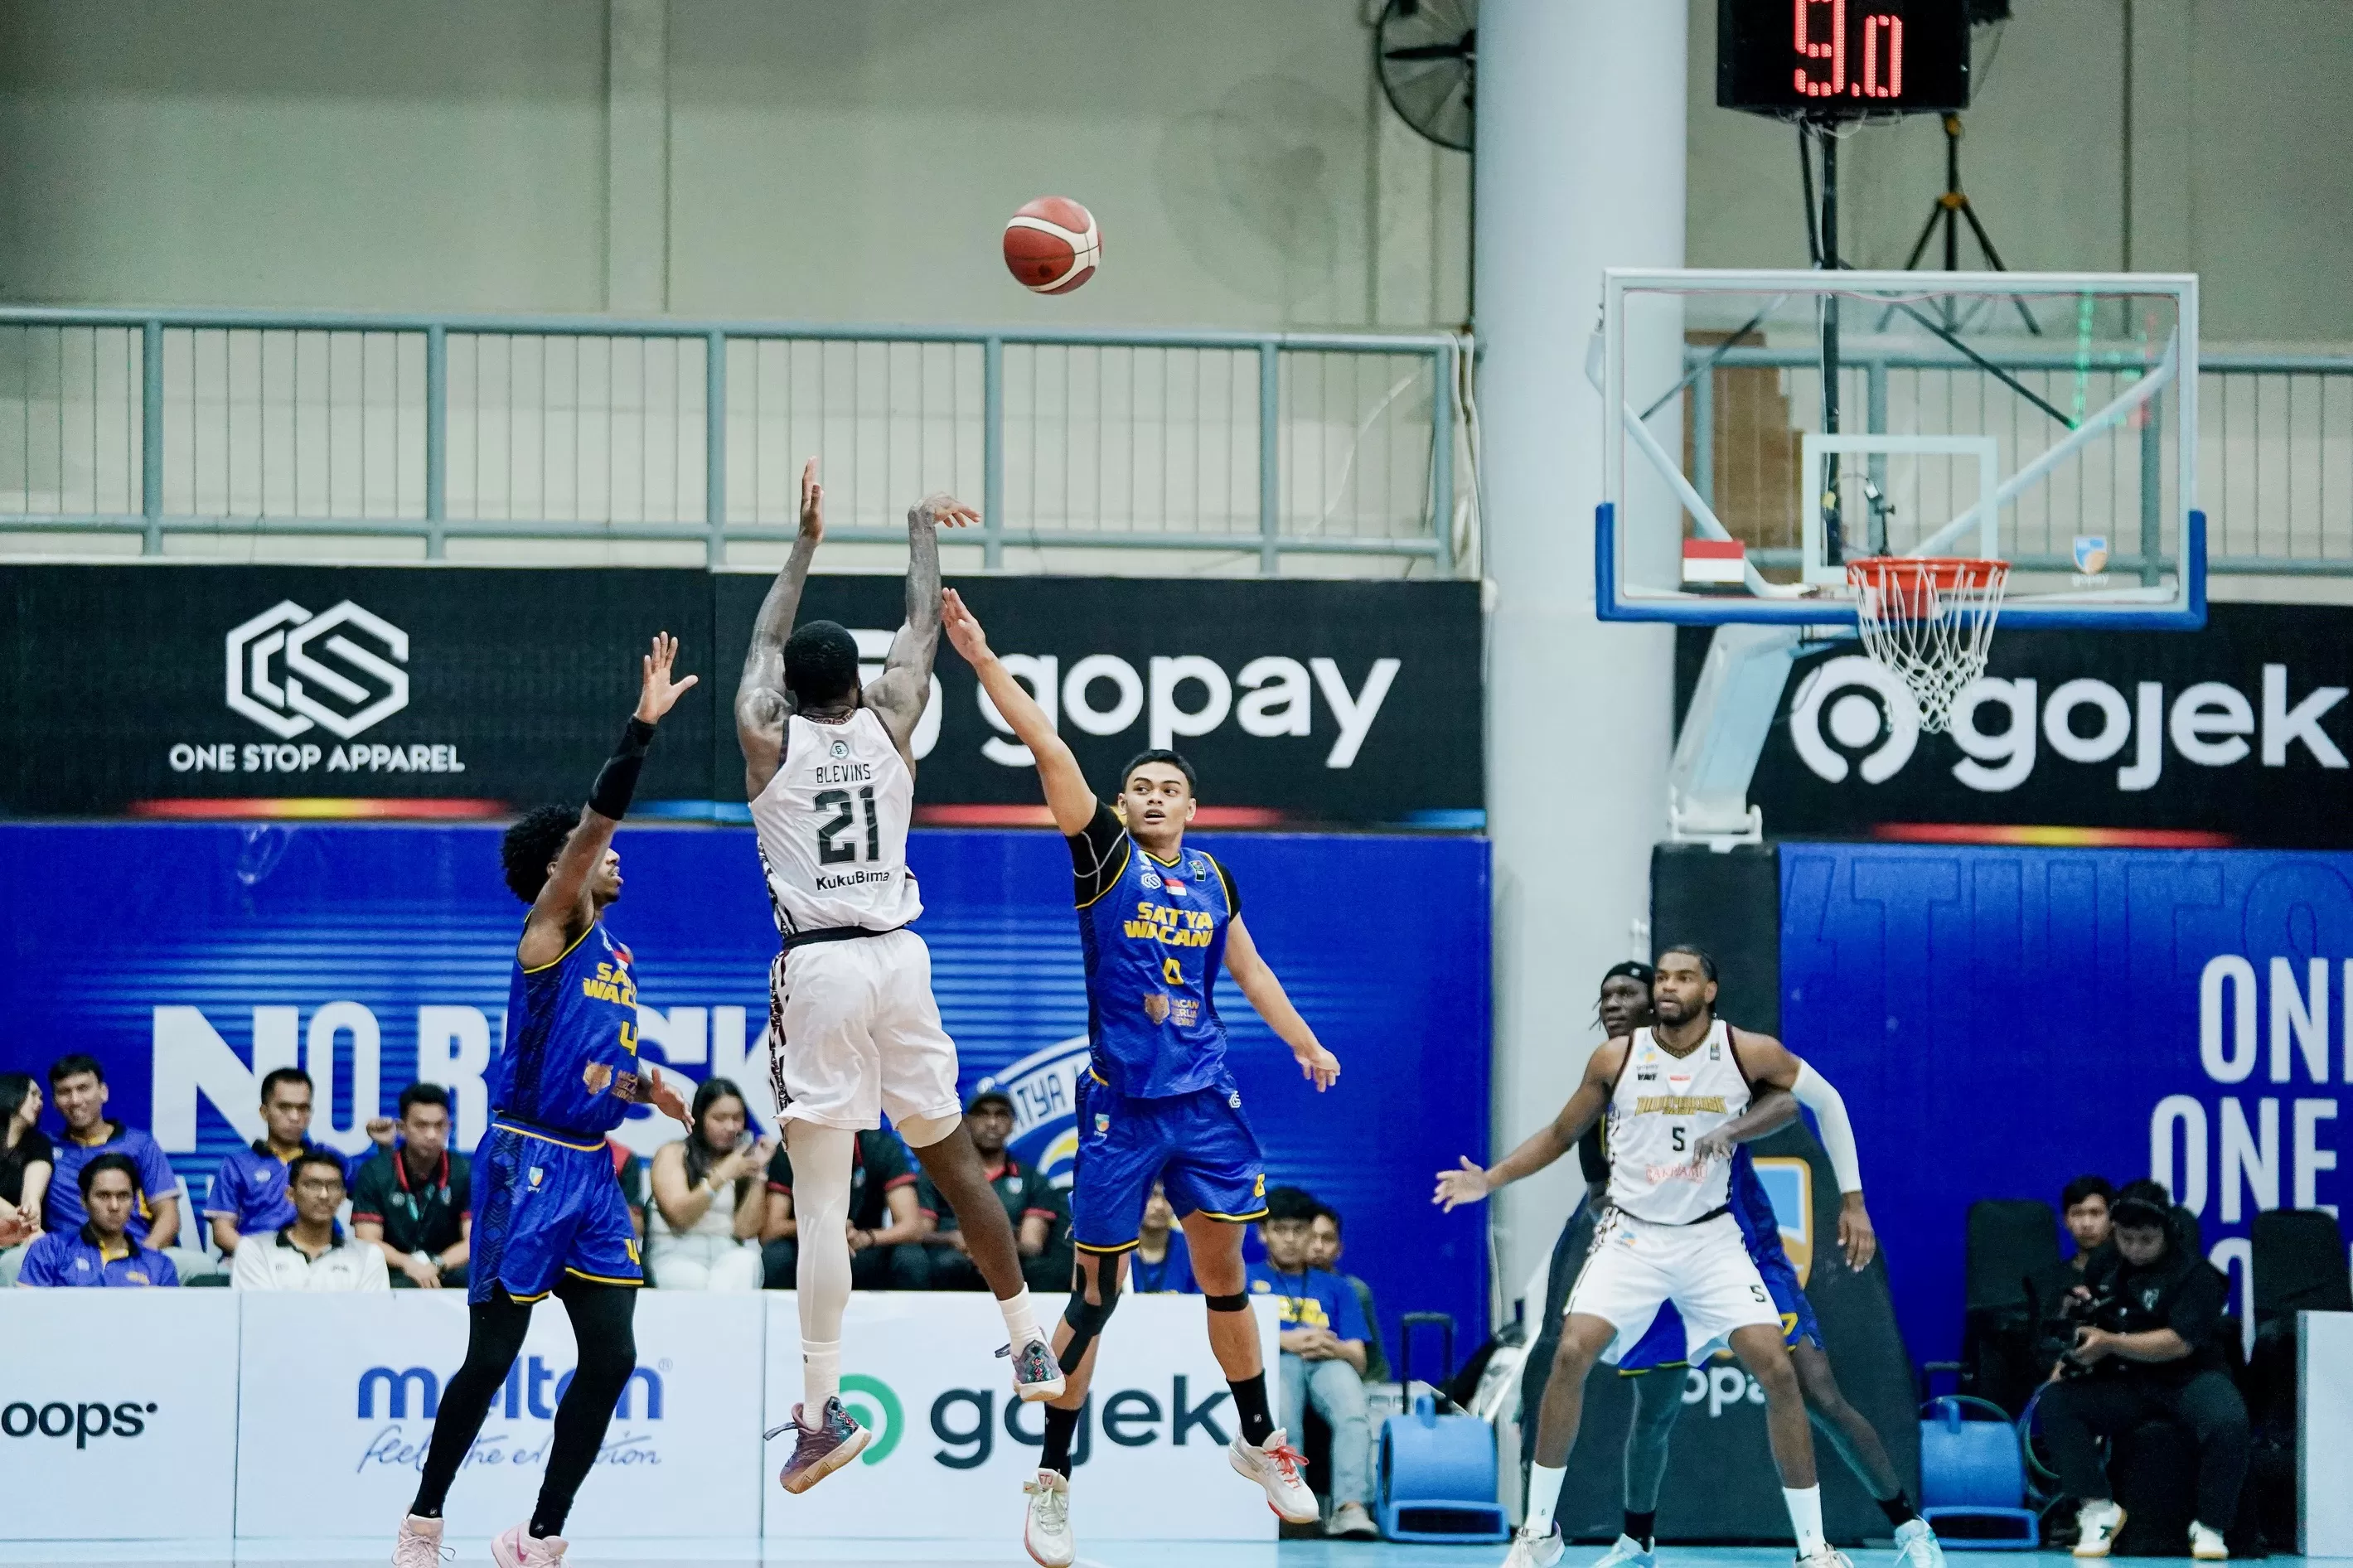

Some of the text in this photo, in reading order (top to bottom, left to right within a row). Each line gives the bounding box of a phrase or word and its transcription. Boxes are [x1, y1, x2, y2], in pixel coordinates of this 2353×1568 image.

[1793, 0, 1903, 98] 9.0
[976, 653, 1402, 769] gopay
[1950, 663, 2351, 792] gojek
[169, 743, 466, 773] ONE STOP APPAREL
[816, 763, 871, 784] BLEVINS
[812, 785, 881, 866] 21
[816, 870, 890, 891] KukuBima
[1123, 920, 1214, 947] WACAN
[1137, 902, 1214, 930] SATYA
[583, 977, 637, 1009] WAC
[619, 1020, 638, 1057] 4
[2200, 954, 2353, 1085] ON
[152, 1001, 381, 1155] NO
[1015, 1071, 1068, 1128] TYA
[1672, 1126, 1686, 1152] 5
[2150, 1094, 2339, 1224] ONE
[1750, 1285, 1767, 1303] 5
[357, 1355, 665, 1420] mltn
